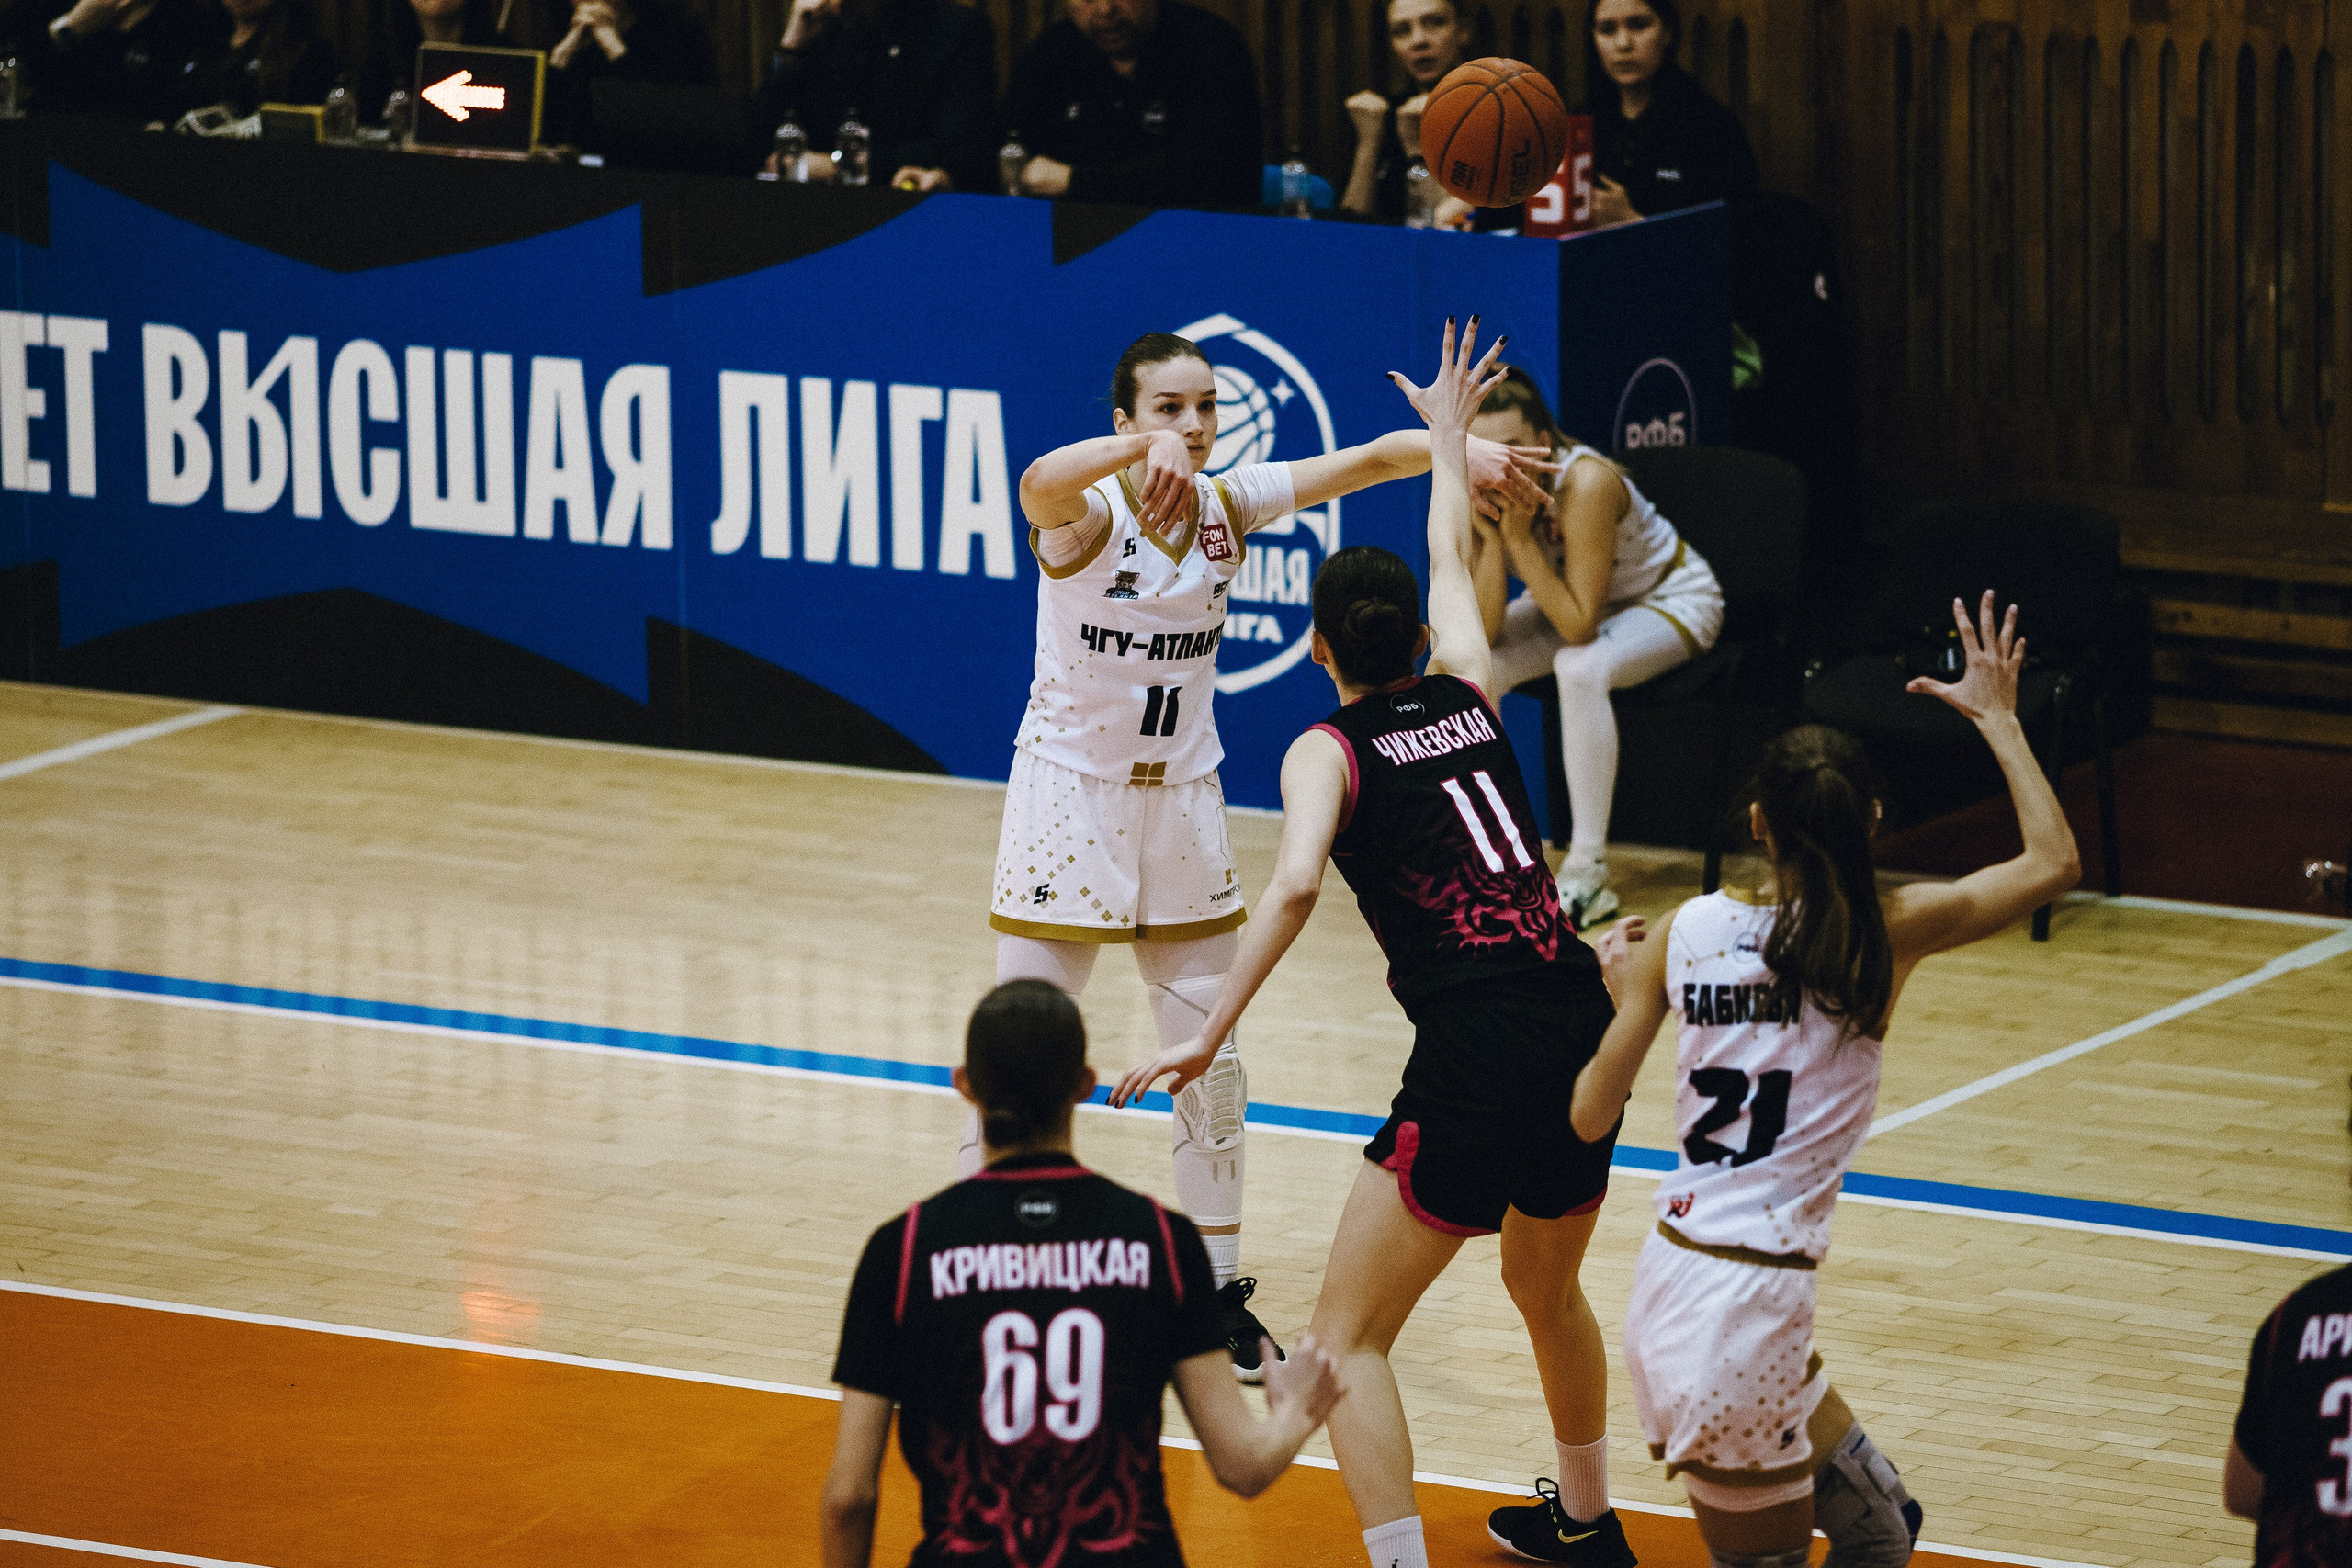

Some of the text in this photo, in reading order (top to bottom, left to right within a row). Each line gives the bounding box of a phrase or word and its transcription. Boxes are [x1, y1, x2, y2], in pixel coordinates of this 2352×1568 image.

[142, 322, 673, 550] ВЫСШАЯ
[711, 369, 1016, 579] ЛИГА
[1202, 528, 1224, 545] FON
[1206, 541, 1227, 558] BET
[1139, 685, 1183, 737] 11
[1371, 706, 1498, 767] ЧИЖЕВСКАЯ
[1396, 703, 1419, 714] РФБ
[1440, 770, 1536, 873] 11
[1684, 1067, 1792, 1168] 21
[930, 1238, 1151, 1300] КРИВИЦКАЯ
[981, 1307, 1105, 1446] 69
